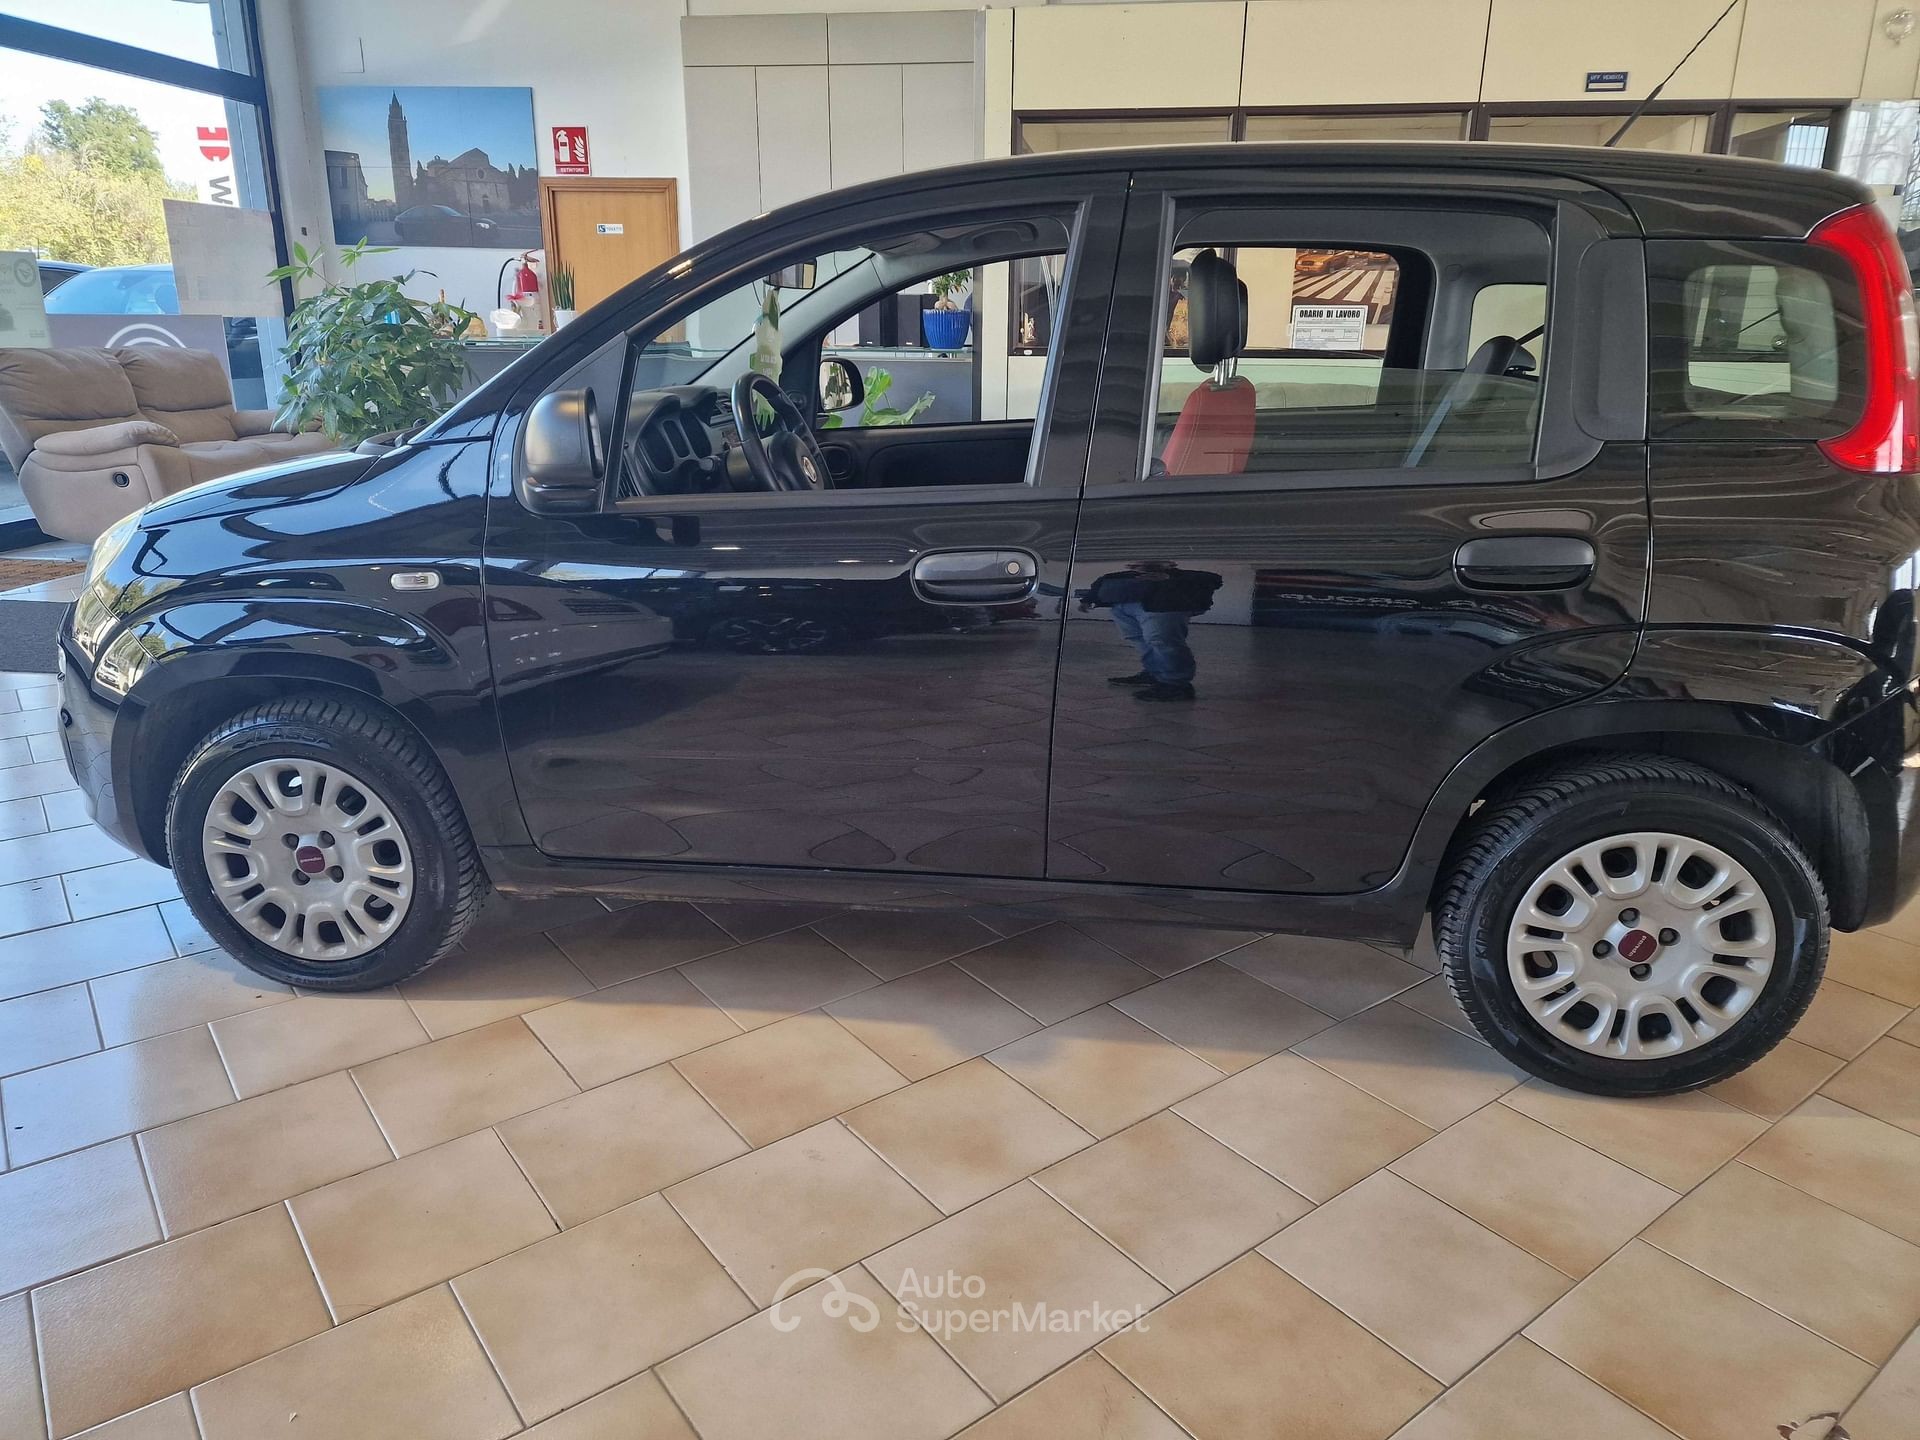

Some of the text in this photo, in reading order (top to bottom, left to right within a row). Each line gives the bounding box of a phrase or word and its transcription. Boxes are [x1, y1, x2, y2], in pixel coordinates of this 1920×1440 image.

[1299, 309, 1361, 319] ORARIO DI LAVORO
